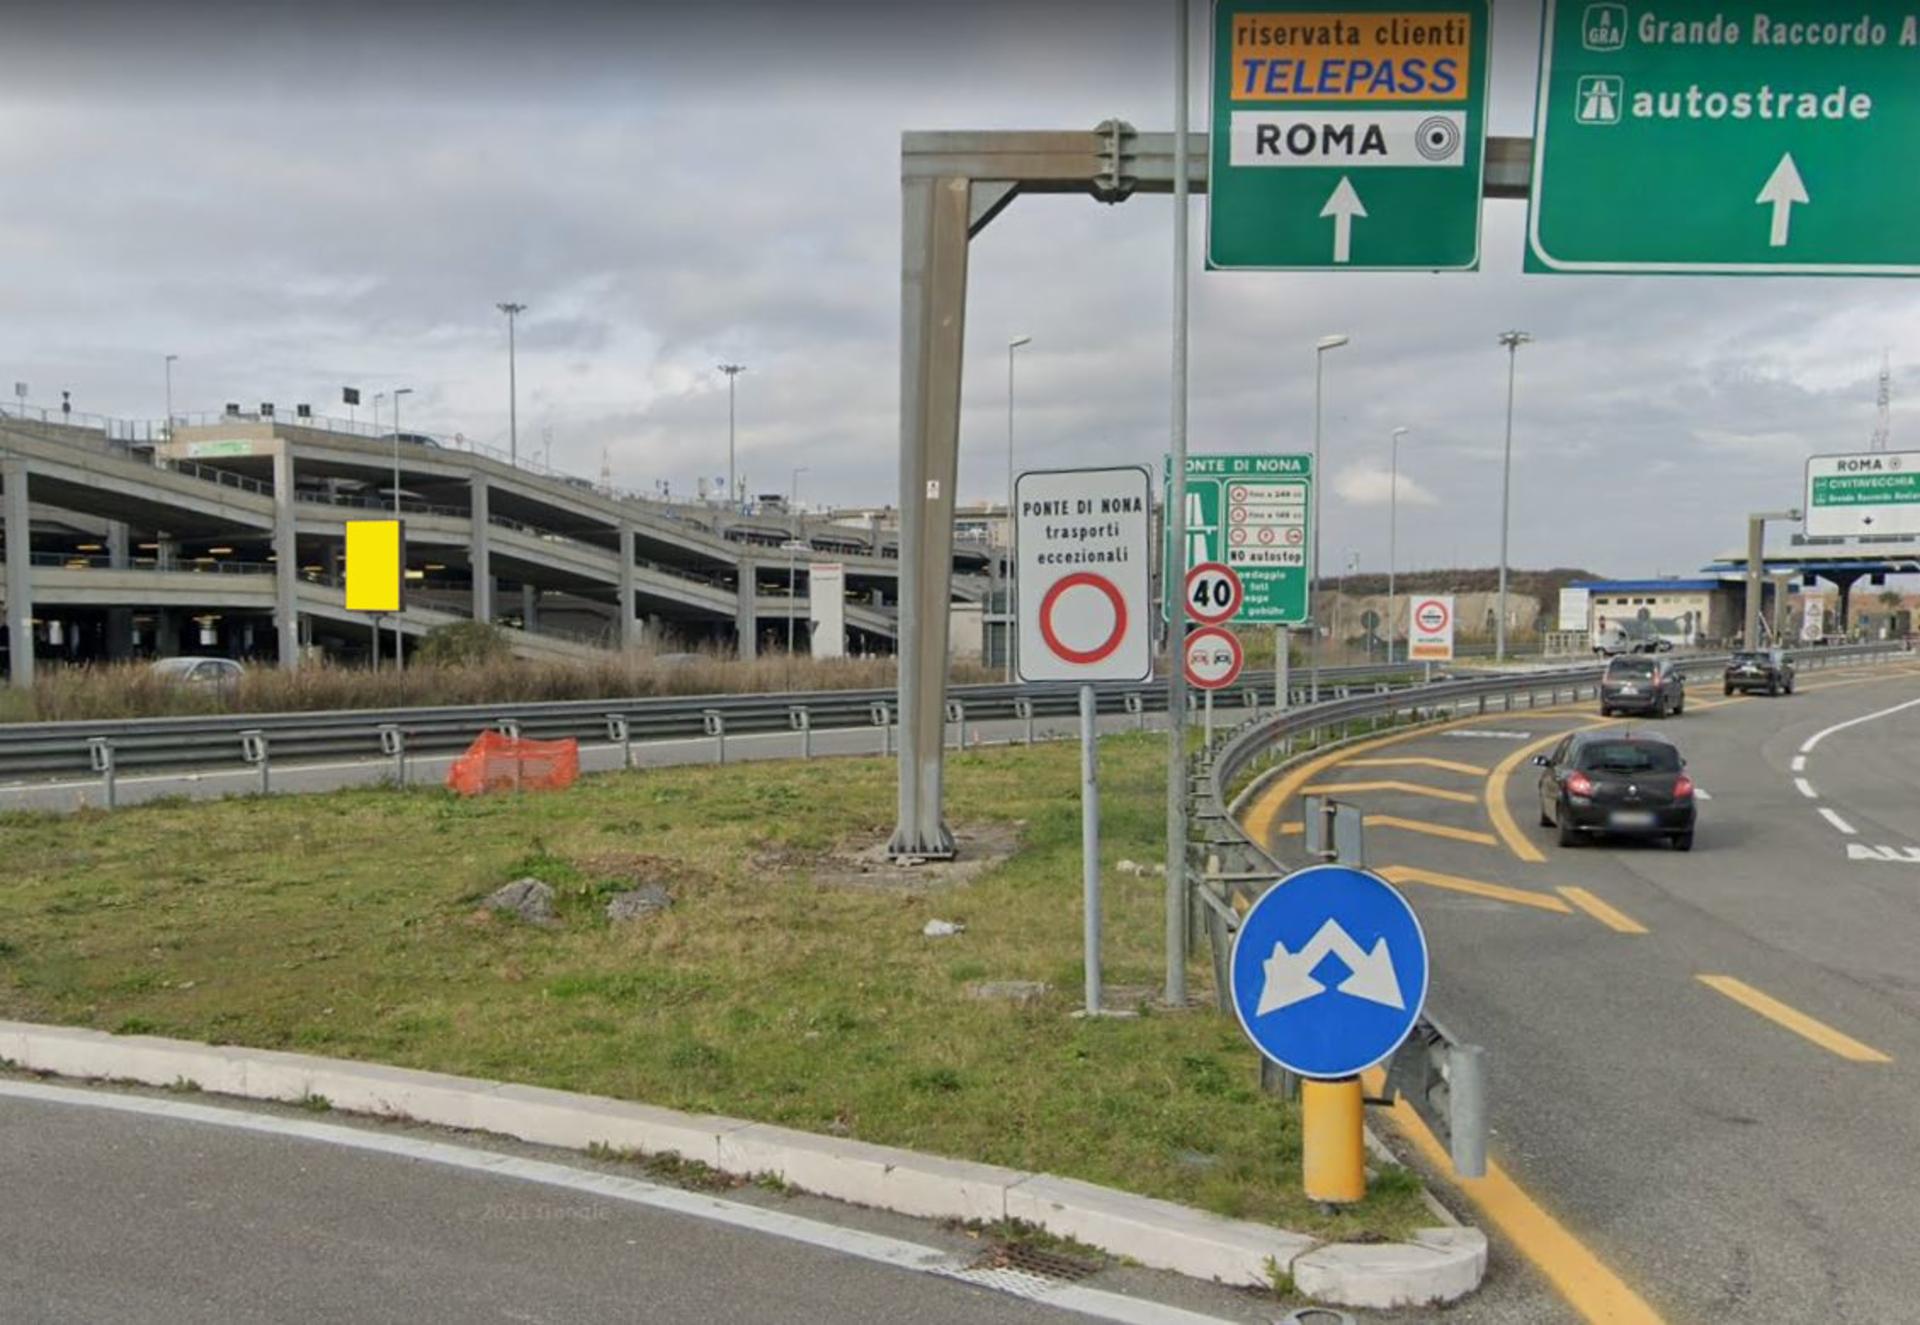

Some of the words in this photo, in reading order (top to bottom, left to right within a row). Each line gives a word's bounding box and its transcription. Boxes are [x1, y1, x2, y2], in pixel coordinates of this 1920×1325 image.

[1237, 19, 1361, 46] riservata
[1375, 18, 1466, 46] clienti
[1588, 27, 1620, 44] GRA
[1637, 12, 1740, 44] Grande
[1751, 14, 1887, 46] Raccordo
[1243, 58, 1458, 94] TELEPASS
[1631, 83, 1873, 120] autostrade
[1255, 122, 1389, 156] ROMA
[1186, 459, 1225, 473] ONTE
[1233, 459, 1250, 472] DI
[1255, 458, 1302, 473] NONA
[1837, 459, 1883, 472] ROMA
[1828, 476, 1915, 489] CIVITAVECCHIA
[1023, 500, 1069, 517] PONTE
[1077, 499, 1092, 515] DI
[1101, 497, 1142, 514] NONA
[1046, 522, 1119, 541] trasporti
[1038, 547, 1128, 564] eccezionali
[1231, 551, 1245, 561] NO
[1250, 551, 1302, 564] autostop
[1193, 579, 1231, 607] 40
